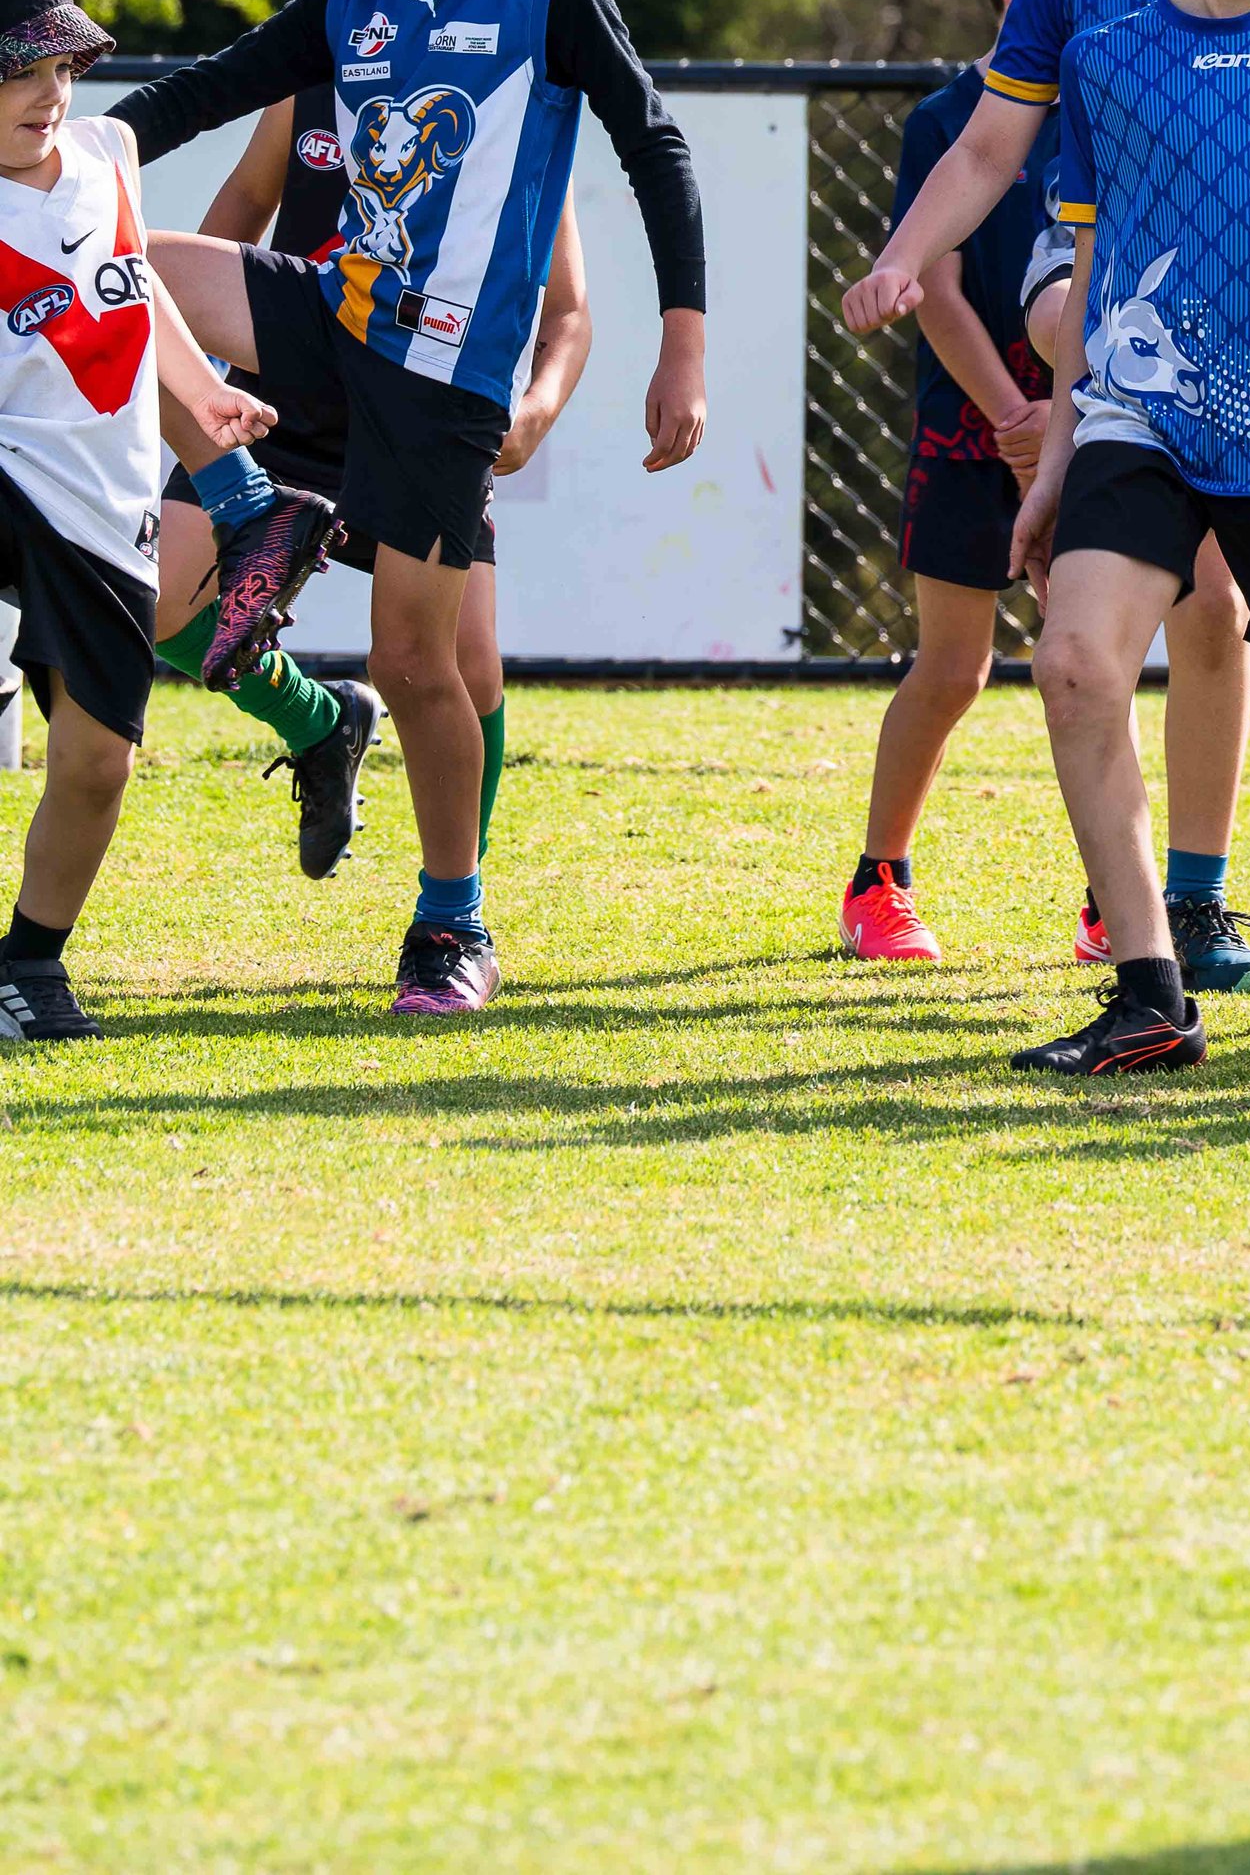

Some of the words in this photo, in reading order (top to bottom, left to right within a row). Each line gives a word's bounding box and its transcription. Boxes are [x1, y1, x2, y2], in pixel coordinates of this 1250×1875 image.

[435, 35, 457, 47] ORN
[343, 66, 389, 78] EASTLAND
[301, 136, 341, 165] AFL
[18, 291, 70, 333] AFL
[424, 316, 455, 334] PUMA
